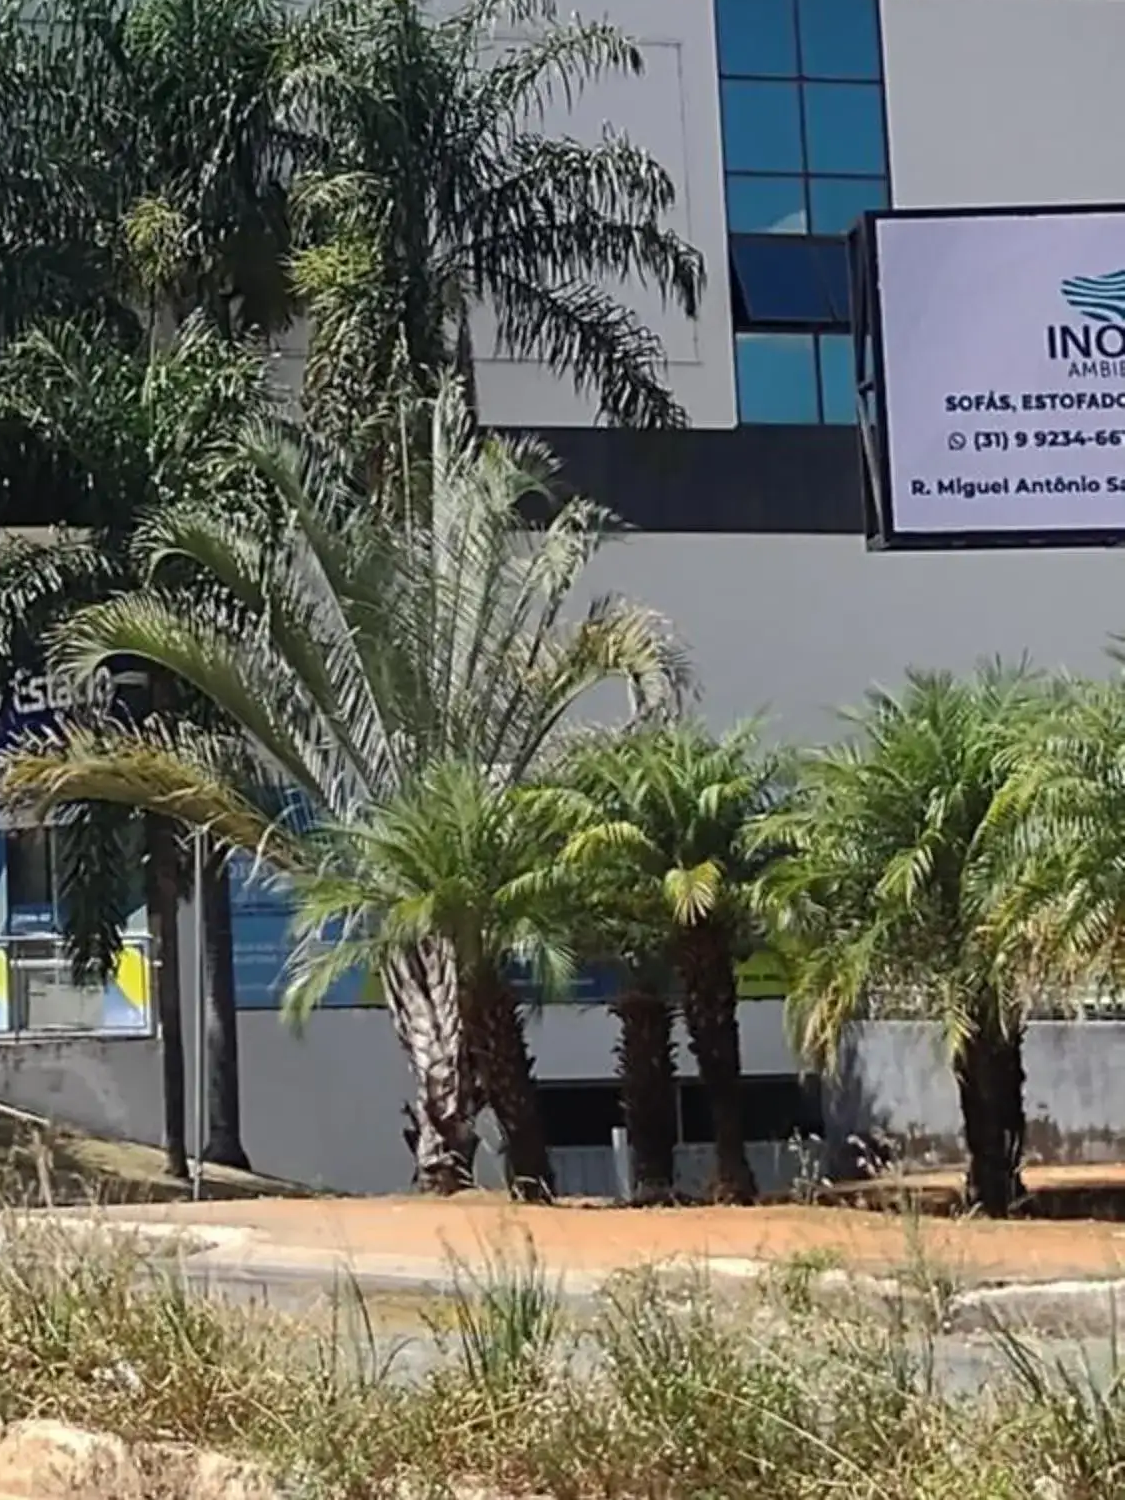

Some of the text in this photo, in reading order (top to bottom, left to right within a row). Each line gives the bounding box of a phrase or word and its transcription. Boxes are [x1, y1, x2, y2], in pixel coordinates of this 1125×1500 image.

[945, 390, 1017, 412] SOFÁS,
[974, 431, 1008, 451] (31)
[1015, 431, 1028, 447] 9
[911, 479, 931, 495] R.
[937, 477, 1009, 498] Miguel
[1015, 475, 1101, 494] Antônio
